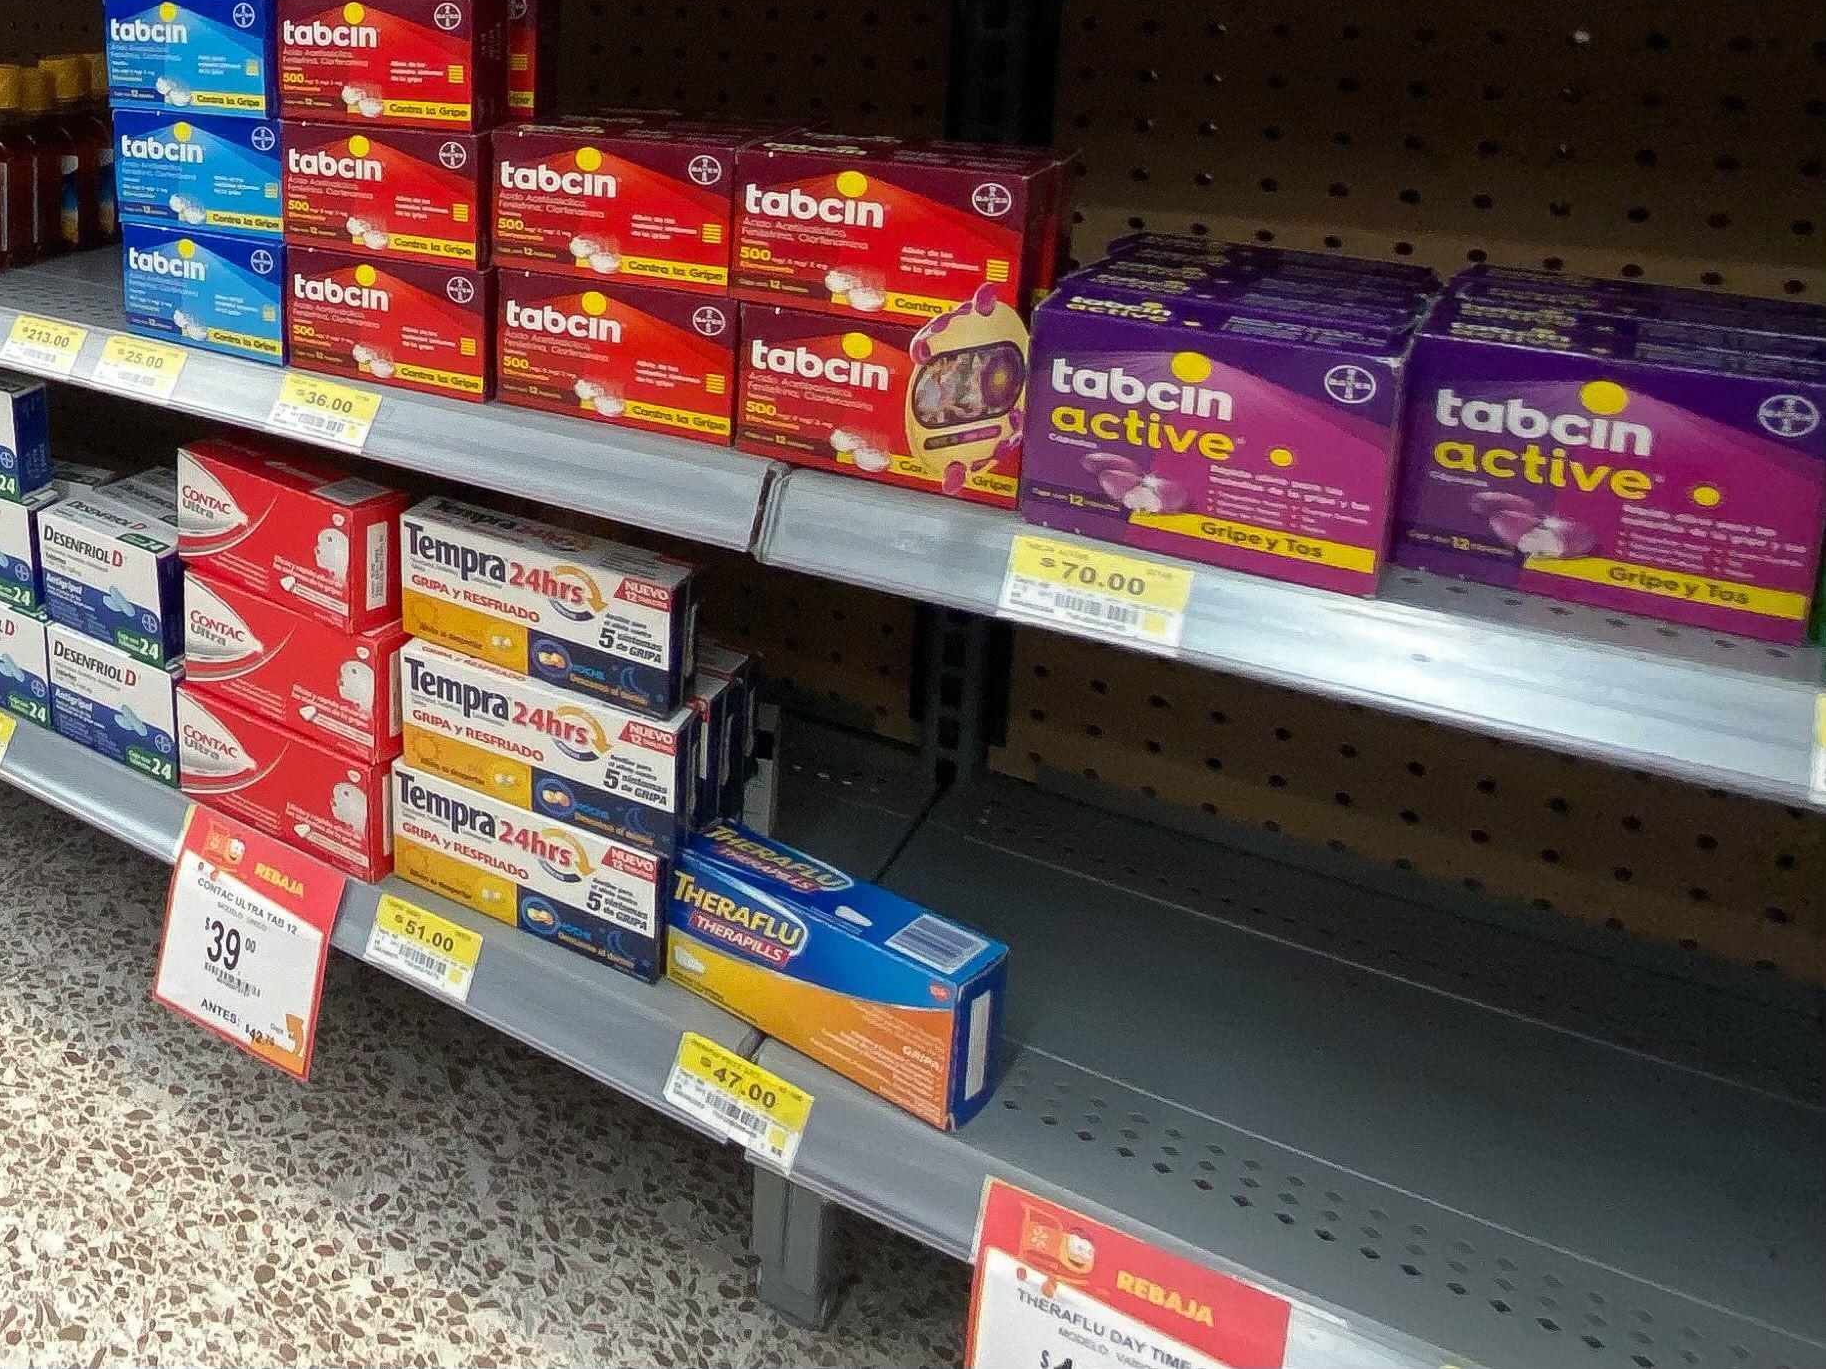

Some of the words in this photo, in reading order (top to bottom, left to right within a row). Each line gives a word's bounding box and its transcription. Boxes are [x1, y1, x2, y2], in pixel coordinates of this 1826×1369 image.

[289, 149, 382, 181] tabcin
[500, 160, 617, 199] tabcin
[745, 184, 885, 227] tabcin
[627, 260, 668, 275] Contra
[689, 265, 723, 282] Gripe
[740, 247, 772, 261] 500
[294, 273, 389, 312] tabcin
[22, 325, 70, 348] $213.00
[505, 300, 621, 343] tabcin
[117, 347, 164, 369] $25.00
[750, 340, 890, 391] tabcin
[295, 388, 353, 414] $36.00
[1052, 358, 1233, 421] tabcin
[1051, 406, 1234, 461] active
[1436, 389, 1653, 456] tabcin
[1434, 441, 1654, 499] active
[44, 526, 112, 564] DESENFRIOL
[112, 549, 124, 568] D
[404, 521, 506, 582] Tempra
[509, 562, 583, 604] 24hrs
[625, 579, 669, 600] NUEVO
[1040, 557, 1147, 597] $70.00
[412, 575, 449, 594] GRIPA
[464, 590, 540, 623] RESFRIADO
[5, 618, 16, 635] D
[190, 610, 244, 642] CONTAC
[191, 623, 226, 645] Ultra
[53, 640, 124, 683] DESENFRIOL
[125, 667, 137, 687] D
[139, 638, 159, 659] 24
[404, 657, 509, 720] Tempra
[512, 702, 588, 744] 24hrs
[184, 725, 238, 758] CONTAC
[184, 738, 219, 761] Ultra
[412, 709, 449, 732] GRIPA
[465, 726, 545, 762] RESFRIADO
[151, 757, 172, 779] 24
[395, 771, 495, 839] Tempra
[498, 820, 571, 865] 24hrs
[402, 822, 439, 843] GRIPA
[454, 842, 529, 880] RESFRIADO
[611, 848, 654, 870] NUEVO
[703, 827, 844, 890] THERAFLU
[253, 862, 305, 898] REBAJA
[586, 890, 602, 911] 5
[197, 878, 233, 904] CONTAC
[234, 893, 265, 918] ULTRA
[266, 911, 285, 928] TAB
[287, 923, 297, 935] 12
[675, 870, 803, 946] THERAFLU
[205, 917, 241, 970] $39
[395, 913, 454, 953] $51.00
[696, 915, 783, 961] THERAPILLS
[200, 997, 242, 1026] ANTES:
[700, 1055, 777, 1110] $47.00
[1116, 1270, 1215, 1328] REBAJA
[1017, 1287, 1106, 1336] THERAFLU
[1110, 1330, 1147, 1354] DAY
